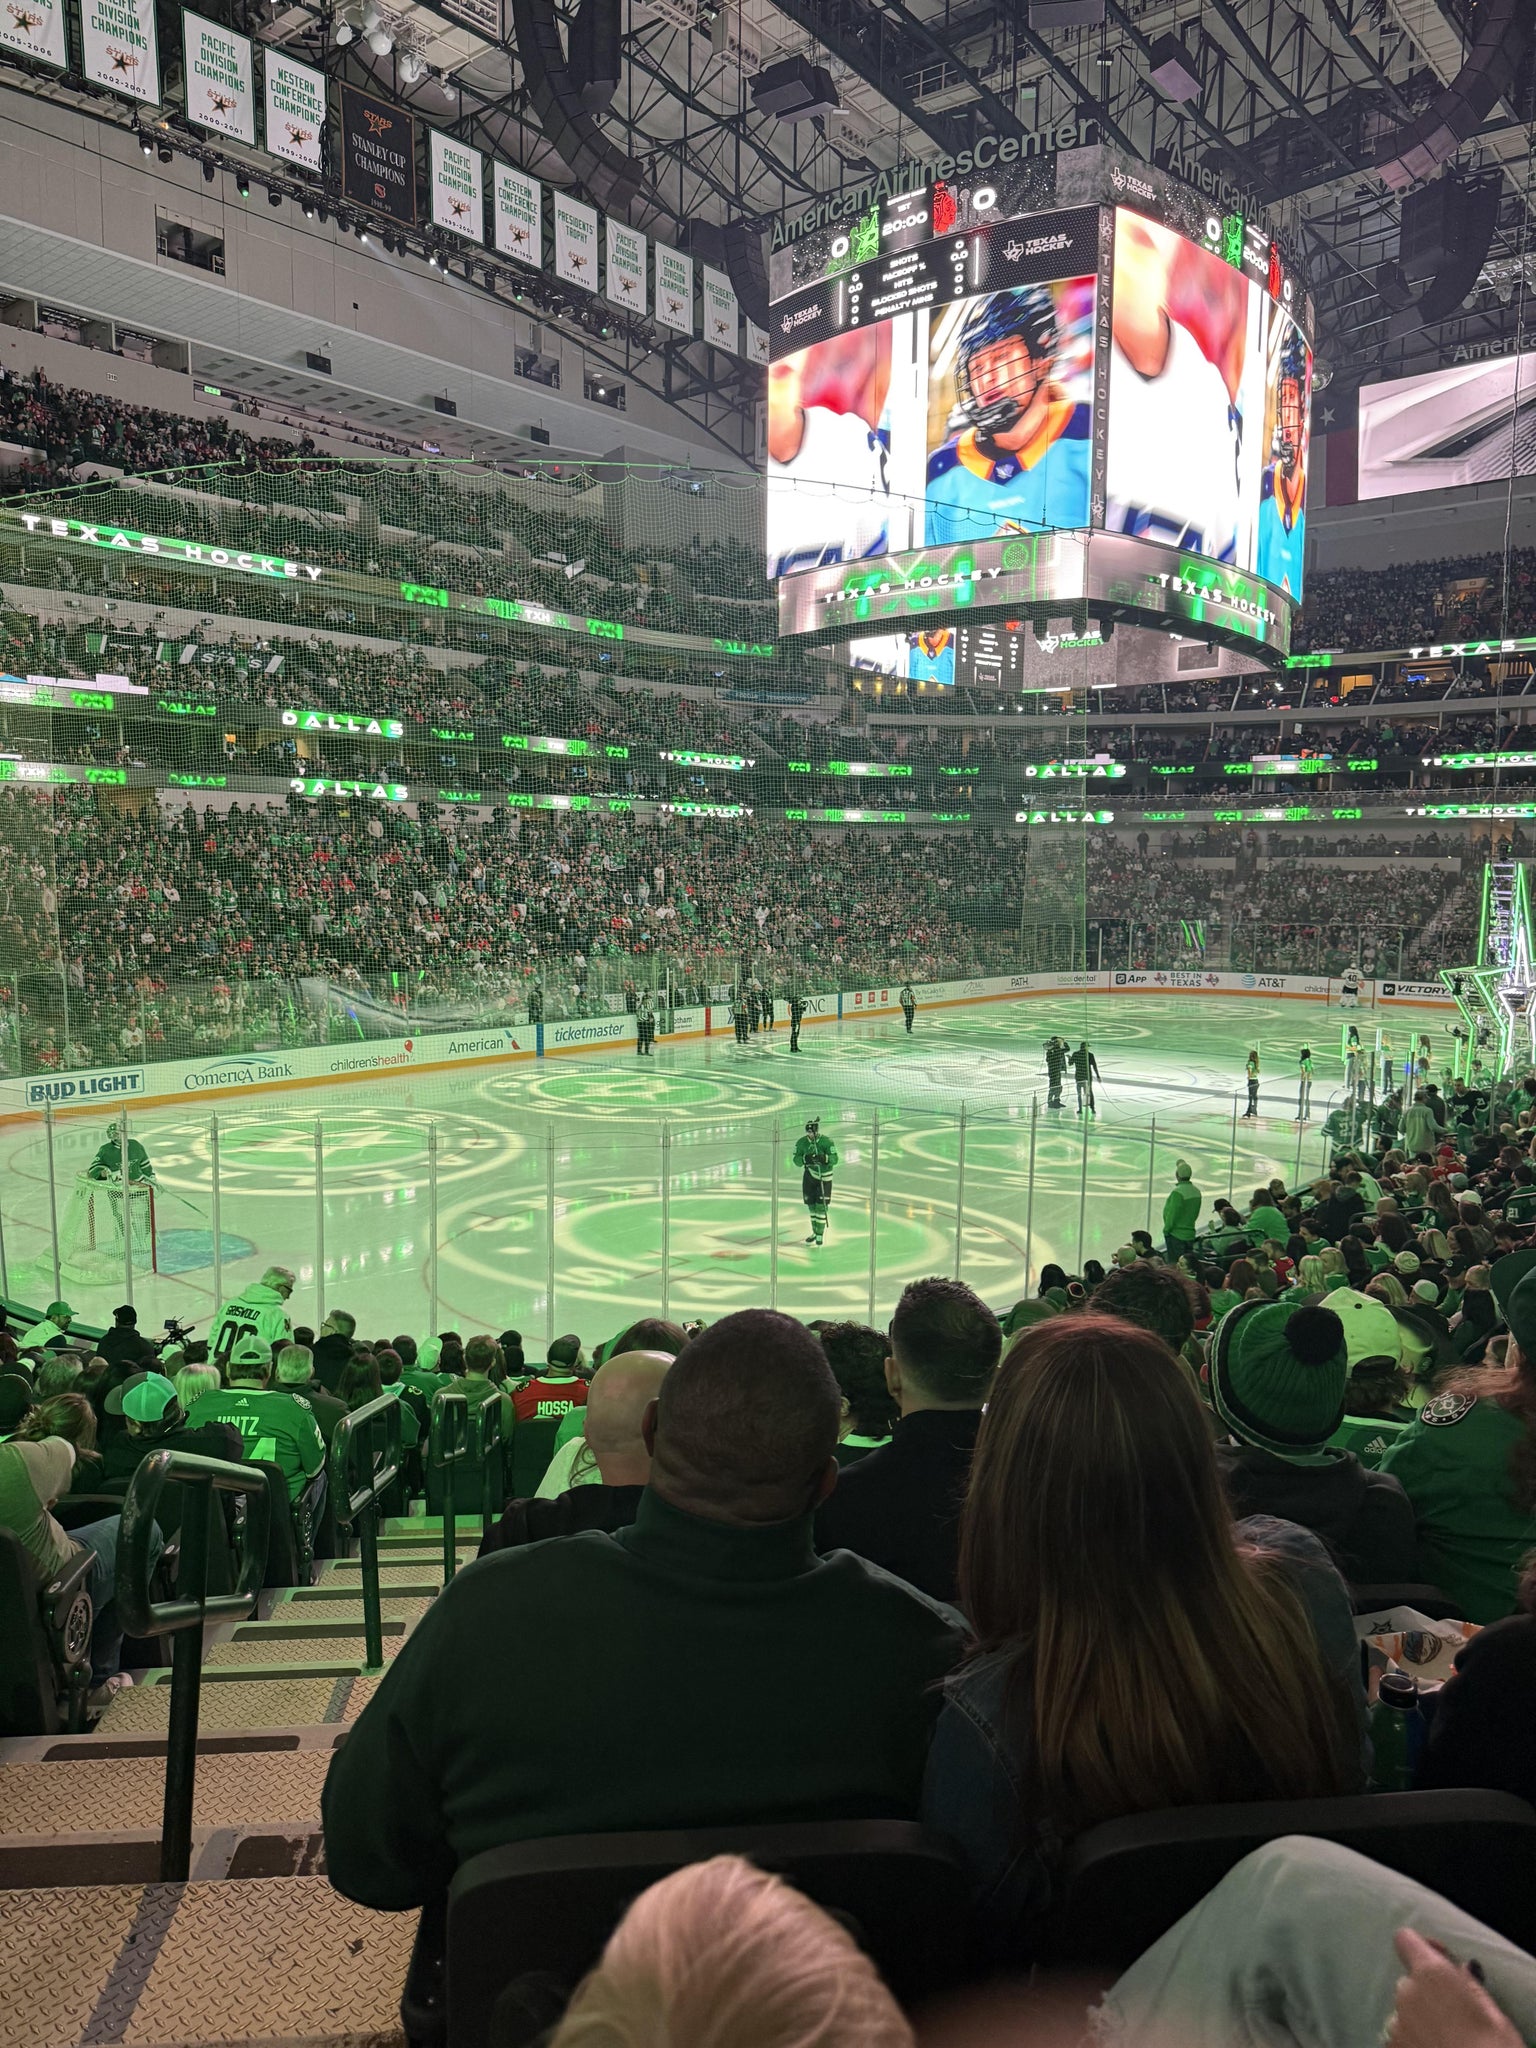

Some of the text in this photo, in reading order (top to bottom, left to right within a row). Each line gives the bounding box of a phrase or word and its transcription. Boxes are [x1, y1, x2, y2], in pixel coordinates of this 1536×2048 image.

[98, 2, 140, 31] DIVISION
[107, 0, 137, 13] IFIC
[91, 15, 148, 51] CHAMPIONS
[201, 32, 236, 59] PACIFIC
[200, 47, 238, 75] DIVISION
[97, 71, 146, 95] 2002-2003
[194, 60, 245, 93] CHAMPIONS
[277, 67, 315, 95] WESTERN
[270, 79, 322, 113] CONFERENCE
[273, 95, 320, 126] CHAMPIONS
[363, 109, 392, 129] STARS
[198, 112, 243, 135] 2000-2001
[277, 145, 318, 165] 1999-2000
[352, 132, 406, 169] STANLEY CUP
[444, 148, 470, 170] PACIFIC
[355, 153, 405, 186] CHAMPIONS
[443, 161, 472, 184] DIVISION
[438, 172, 477, 199] CHAMPIONS
[503, 176, 532, 199] WESTERN
[1126, 175, 1153, 192] TEXAS
[1126, 183, 1157, 201] HOCKEY
[498, 187, 538, 214] CONFERENCE
[973, 188, 996, 210] 0
[500, 201, 536, 226] CHAMPIONS
[557, 209, 594, 235] PRESIDENTS'
[882, 211, 928, 236] 20:00
[441, 216, 474, 235] 1999-2000
[566, 225, 588, 244] TROPHY
[1206, 217, 1220, 241] 0
[616, 232, 638, 251] PACIFIC
[831, 236, 849, 258] 0
[1026, 233, 1067, 247] TEXAS
[1026, 240, 1073, 255] HOCKEY
[615, 243, 639, 263] DIVISION
[889, 252, 919, 268] SHOTS
[1243, 246, 1269, 275] 20:00
[611, 254, 642, 277] CHAMPIONS
[662, 255, 686, 274] CENTRAL
[663, 266, 685, 285] DIVISION
[893, 277, 914, 288] HITS
[659, 277, 689, 298] CHAMPIONS
[871, 281, 938, 307] BLOCKED SHOTS
[712, 295, 730, 311] TROPHY
[793, 304, 818, 319] TEXAS
[874, 300, 911, 317] PENALTY
[793, 309, 822, 327] HOCKEY
[22, 515, 322, 581] TEXAS HOCKEY
[824, 568, 1002, 603] TEXAS HOCKEY
[1159, 574, 1276, 625] TEXAS HOCKEY
[525, 610, 551, 623] TXH
[1060, 631, 1101, 640] TEAS
[201, 651, 263, 669] STAS
[1408, 640, 1516, 660] TEXAS
[158, 701, 217, 716] DALLAS
[282, 711, 404, 738] DALLAS
[1025, 765, 1127, 778] DALLAS
[1421, 756, 1485, 767] TEXAS
[168, 774, 227, 787] DALLAS
[1015, 812, 1115, 824] DALLAS
[1405, 807, 1536, 816] TEXAS HOCK
[1171, 978, 1202, 987] TEXAS
[1258, 977, 1286, 988] AT&T
[554, 1023, 625, 1042] ticketmaster
[448, 1037, 504, 1055] American
[258, 1064, 293, 1079] Bank
[31, 1074, 139, 1102] BUD LIGHT
[1508, 1207, 1519, 1218] 21
[226, 1305, 260, 1320] GRISWOLD
[537, 1400, 575, 1416] HOSSA
[1364, 1445, 1388, 1454] adida
